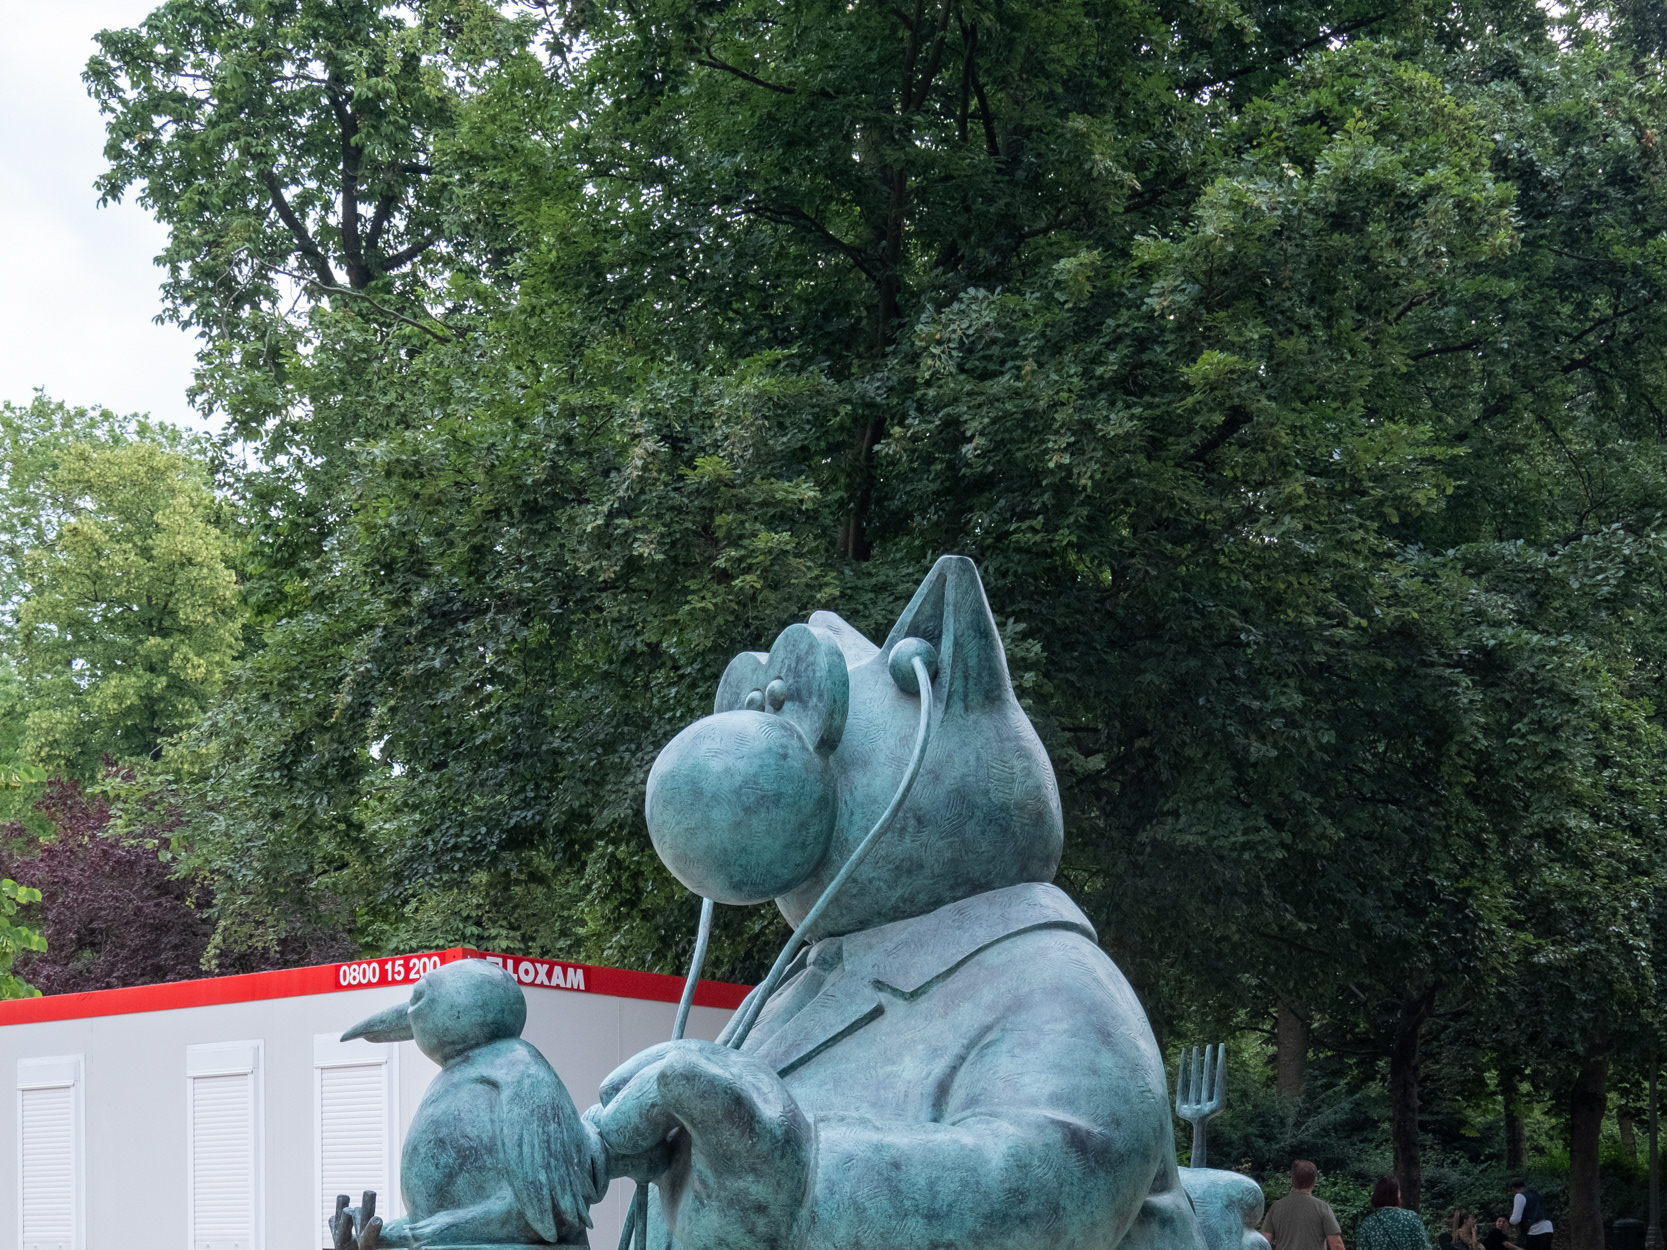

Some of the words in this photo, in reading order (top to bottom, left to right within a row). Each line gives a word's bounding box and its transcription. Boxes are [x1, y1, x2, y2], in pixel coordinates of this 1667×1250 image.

[339, 962, 380, 986] 0800
[384, 959, 405, 982] 15
[409, 956, 441, 979] 200
[507, 958, 585, 991] LOXAM
